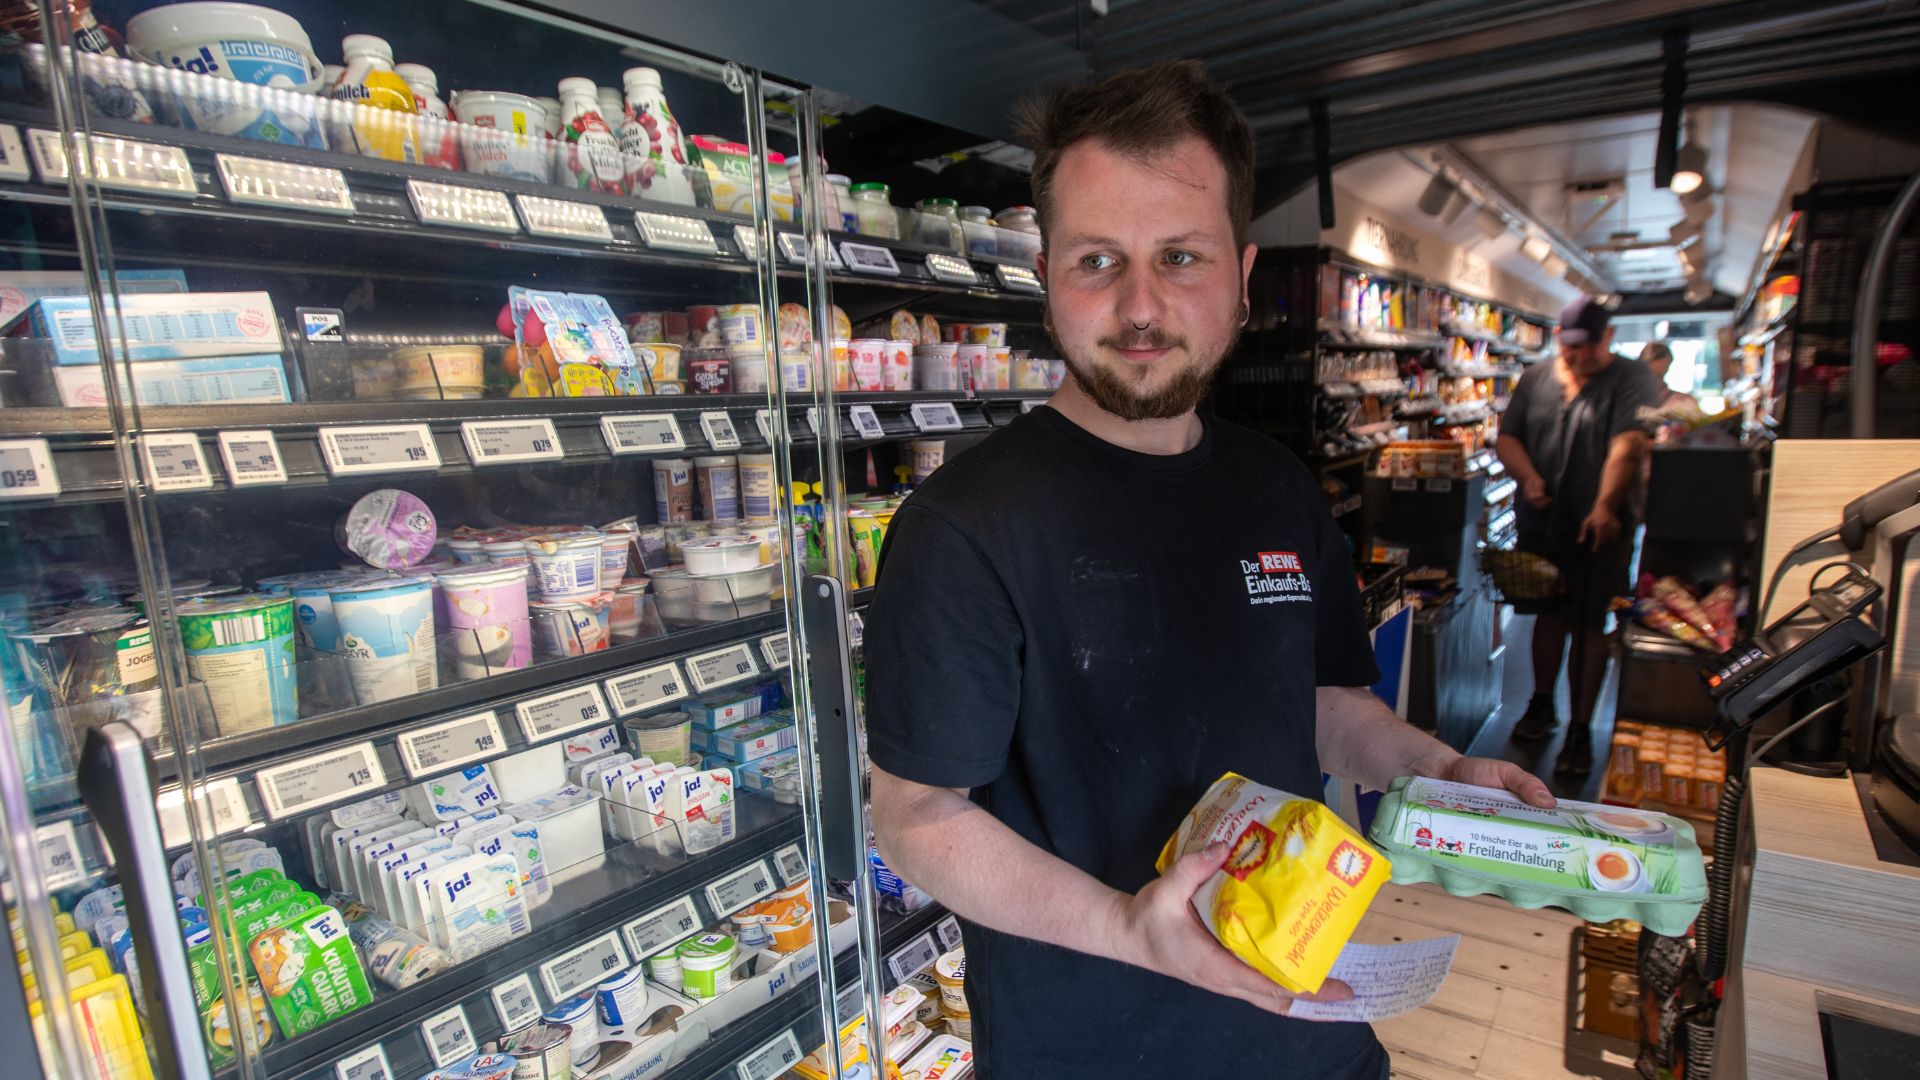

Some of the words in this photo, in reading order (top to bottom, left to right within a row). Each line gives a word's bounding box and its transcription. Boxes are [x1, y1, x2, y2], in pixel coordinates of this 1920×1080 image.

[1240, 559, 1260, 574] Der
[1261, 554, 1300, 570] REWE
[1245, 573, 1312, 595] Einkaufs-Bs
[1250, 597, 1264, 605] Dein
[126, 654, 155, 668] JOGH
[600, 728, 617, 749] ja!
[475, 783, 498, 807] ja!
[648, 779, 666, 803] ja!
[684, 776, 701, 799] ja!
[1236, 835, 1262, 867] Aurora
[1470, 832, 1480, 841] 10
[1480, 833, 1507, 847] frische
[1508, 838, 1524, 849] Eier
[1524, 843, 1539, 851] aus
[1344, 851, 1356, 876] Aurora
[1469, 842, 1566, 873] Freilandhaltung
[445, 872, 473, 903] ja!
[1299, 898, 1319, 919] Type
[309, 915, 339, 940] ja!
[1286, 886, 1347, 969] Weizenmehl
[321, 947, 357, 1009] KRÄUTER
[768, 972, 786, 997] ja!
[311, 970, 341, 1018] QUARK
[474, 1056, 505, 1069] LAC
[924, 1047, 961, 1080] LÄTTA
